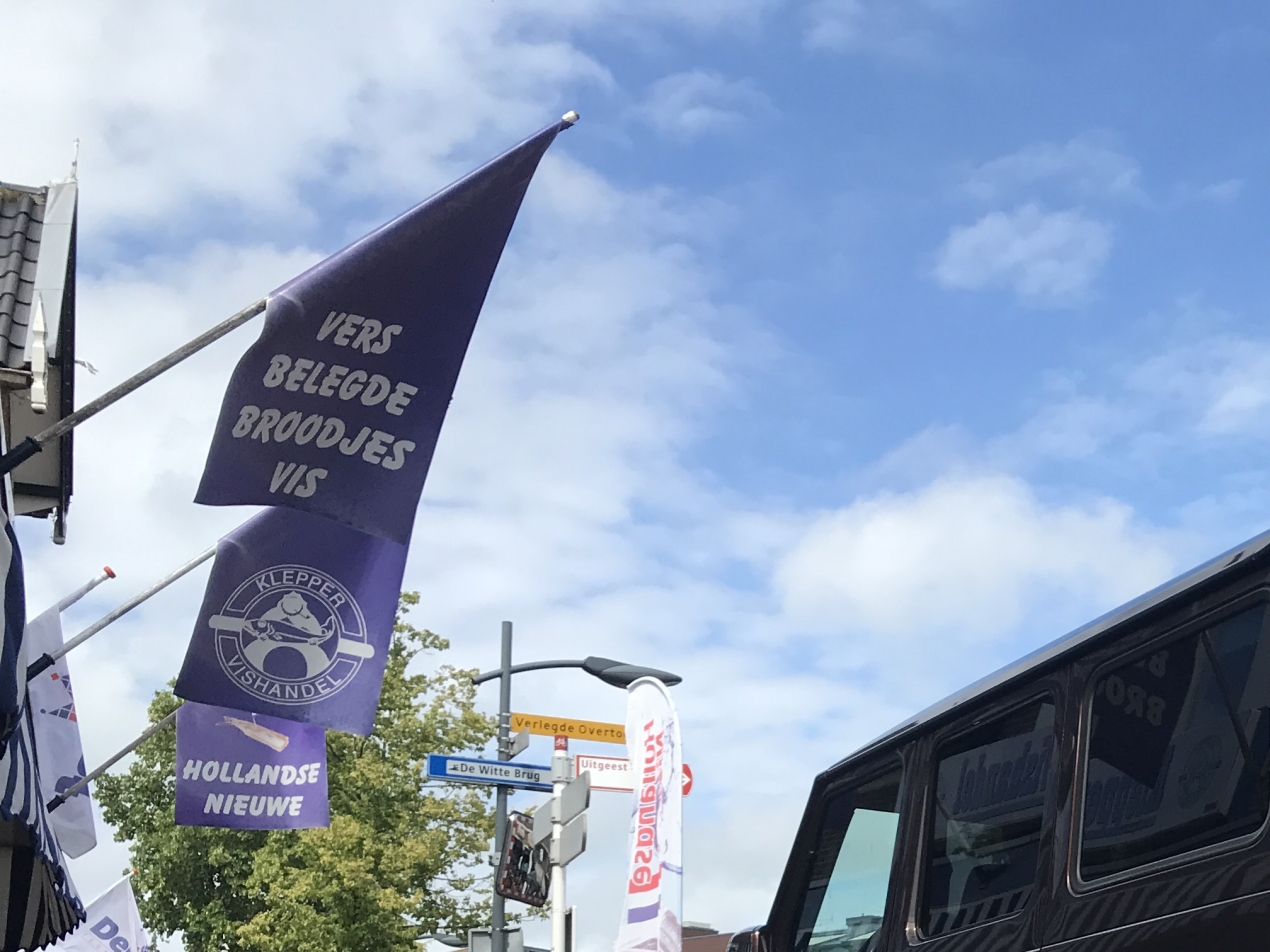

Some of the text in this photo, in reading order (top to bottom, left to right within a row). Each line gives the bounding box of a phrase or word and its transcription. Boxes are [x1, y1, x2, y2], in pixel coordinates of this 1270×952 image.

[316, 310, 403, 354] VERS
[263, 354, 419, 416] BELEGDE
[232, 404, 416, 471] BROODJES
[269, 461, 329, 498] VIS
[255, 570, 346, 609] KLEPPER
[227, 654, 342, 699] VISHANDEL
[515, 717, 625, 738] Verlegde Overto
[183, 759, 321, 785] HOLLANDSE
[460, 763, 541, 782] De Witte Brug
[581, 759, 628, 771] Uitgeest
[204, 793, 303, 817] NIEUWE
